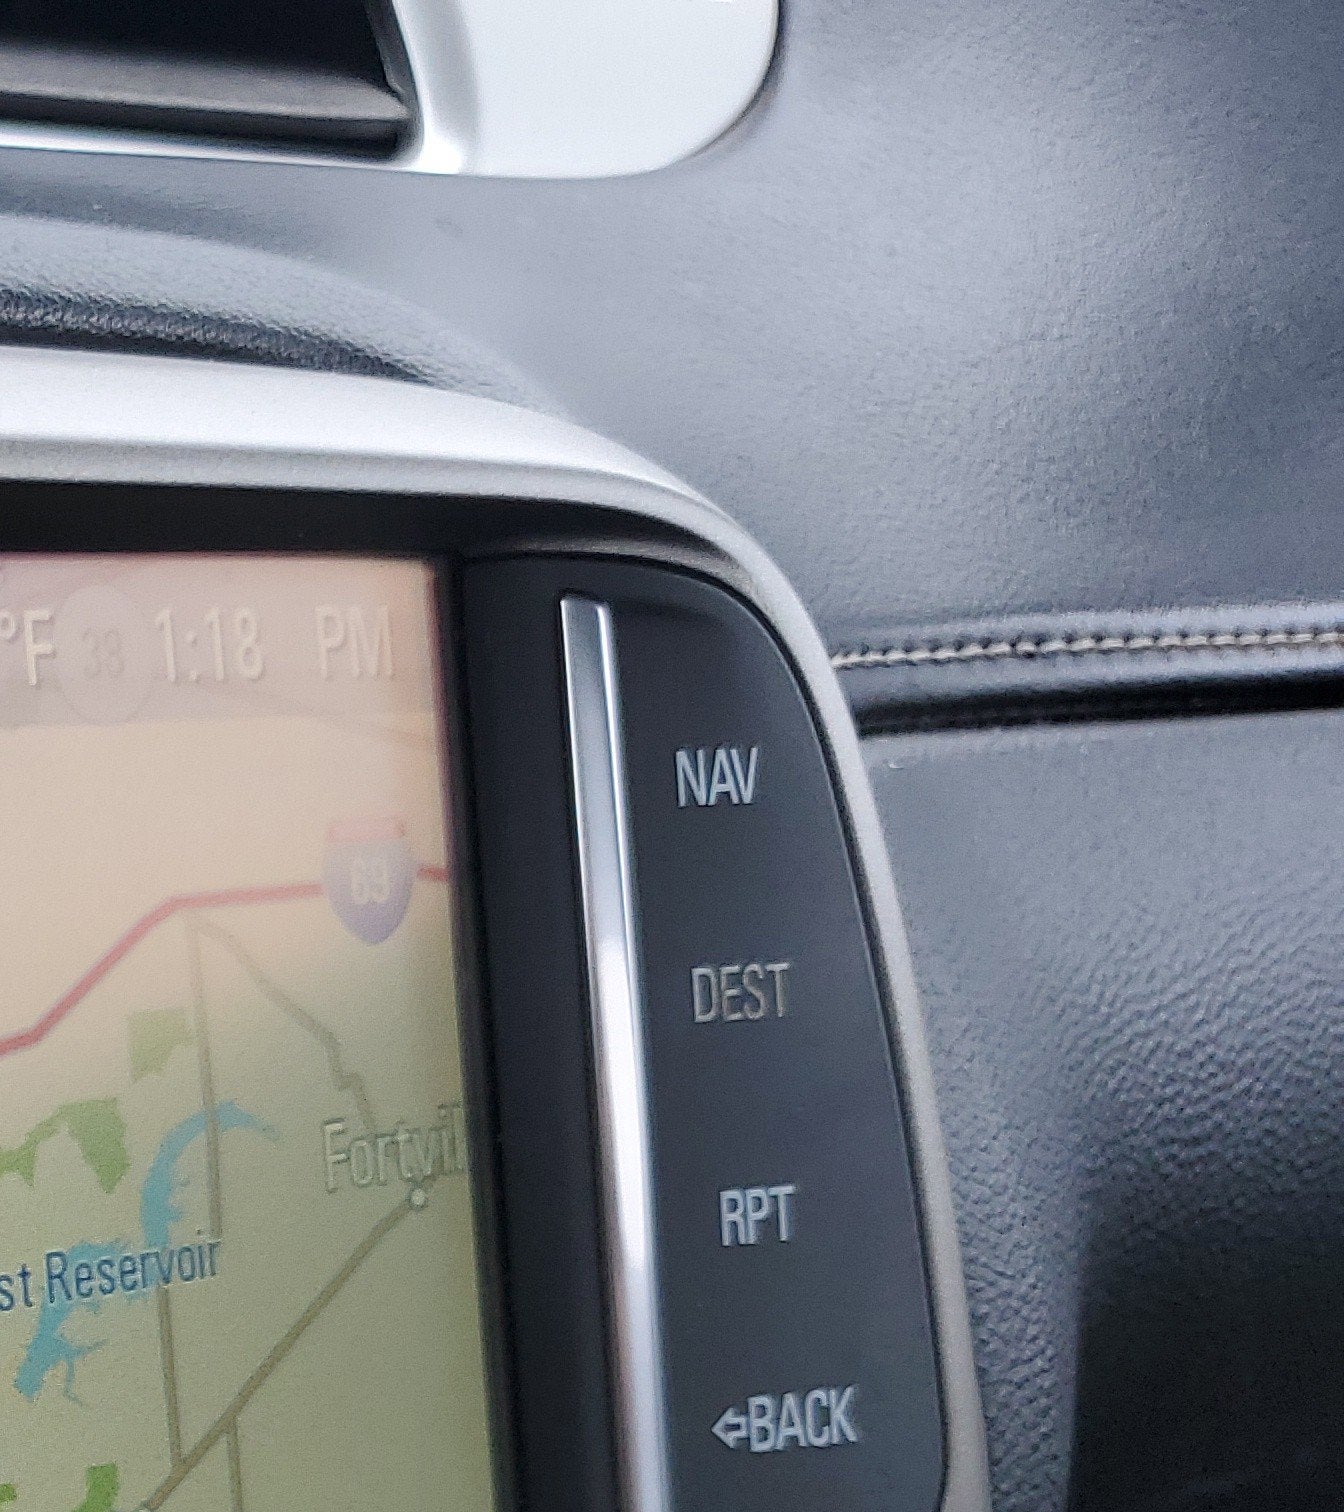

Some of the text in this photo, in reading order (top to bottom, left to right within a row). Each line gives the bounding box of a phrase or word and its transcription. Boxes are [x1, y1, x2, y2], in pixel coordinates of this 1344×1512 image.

[152, 602, 396, 684] 1:18 PM
[675, 747, 760, 807] NAV
[692, 961, 792, 1025] DEST
[719, 1184, 796, 1248] RPT
[43, 1230, 223, 1308] Reservoir
[748, 1383, 860, 1453] BACK
